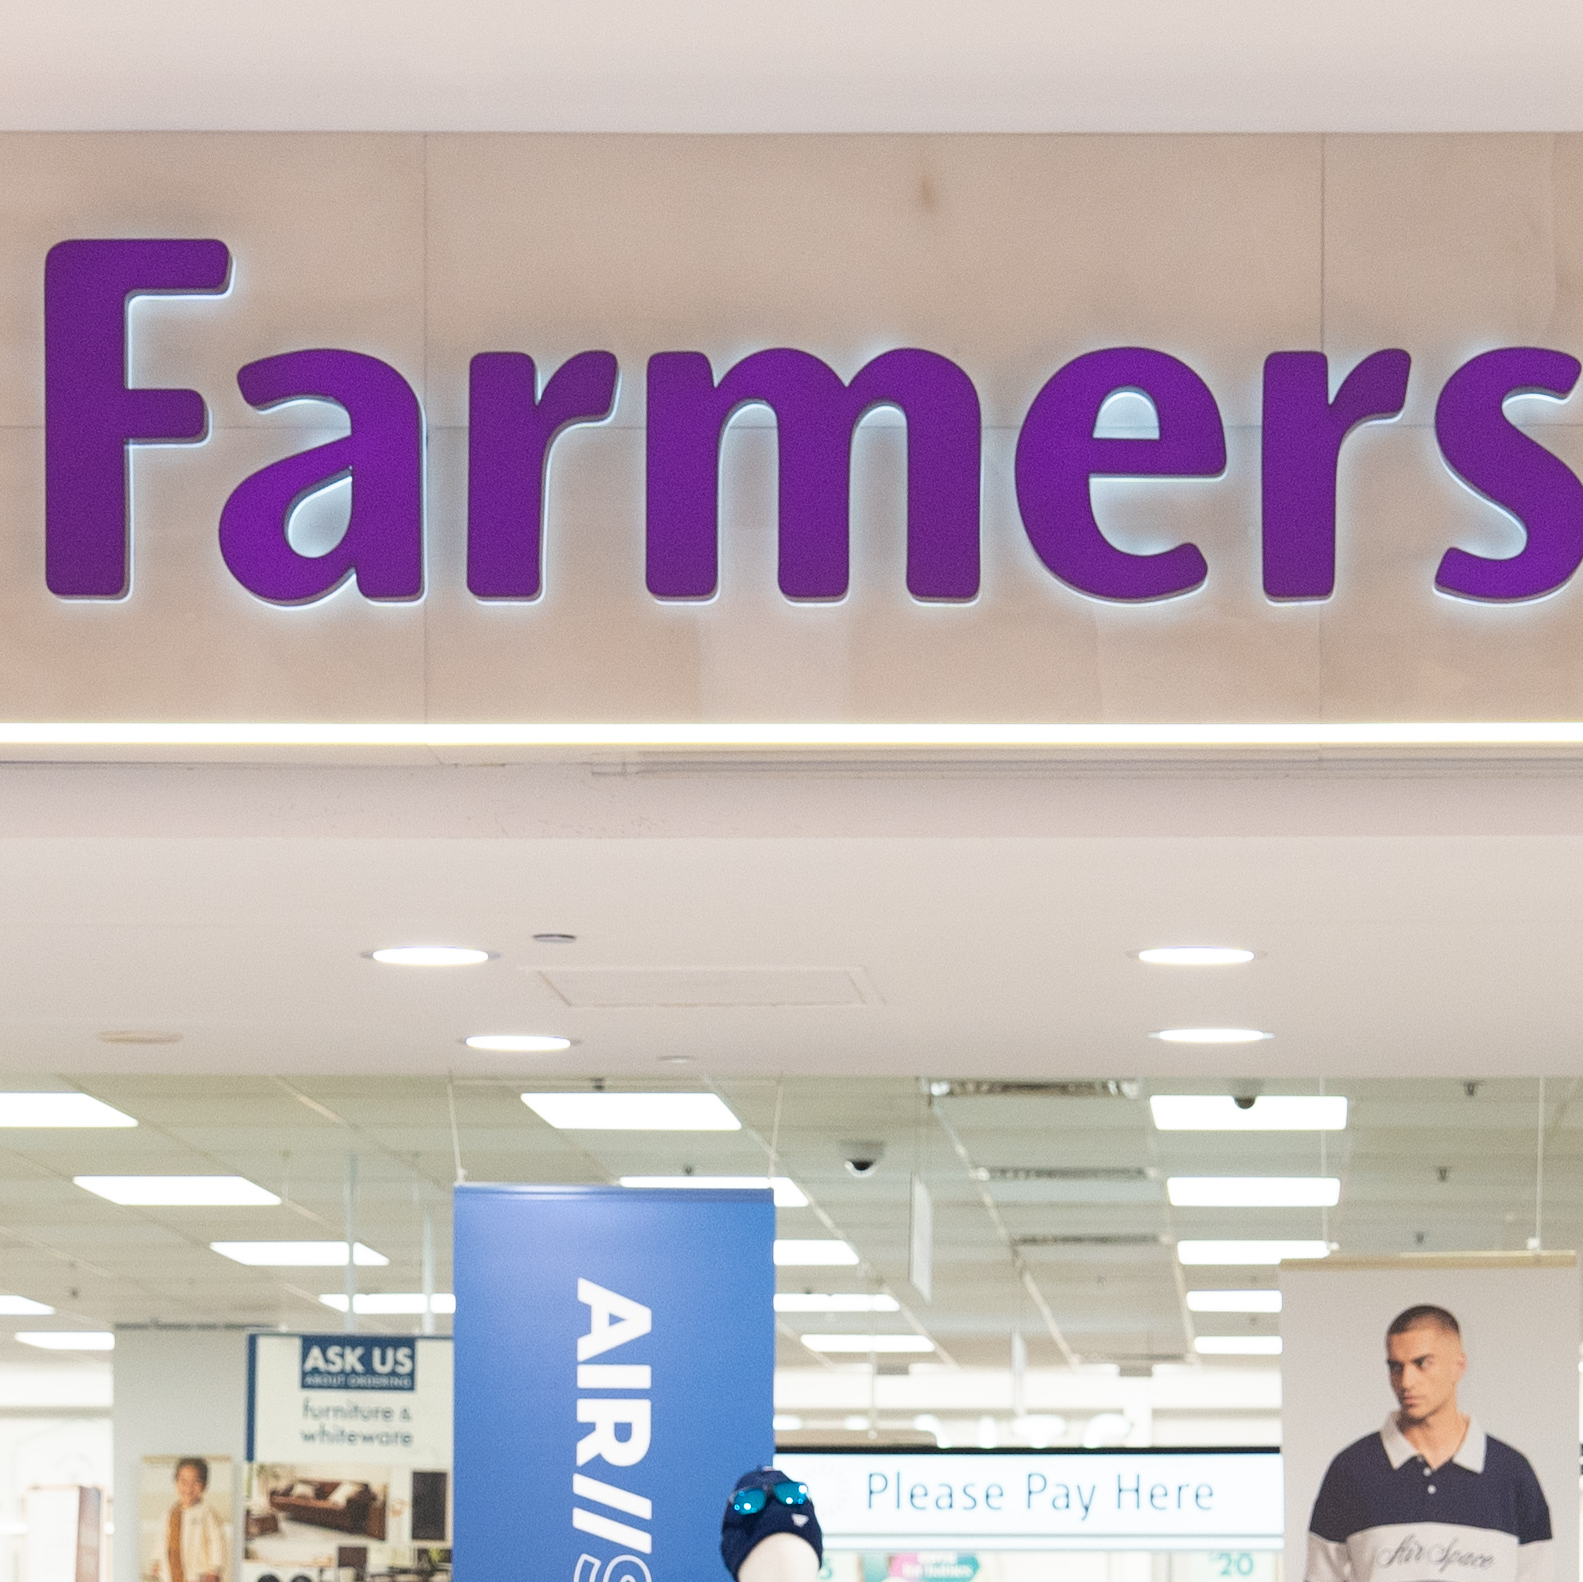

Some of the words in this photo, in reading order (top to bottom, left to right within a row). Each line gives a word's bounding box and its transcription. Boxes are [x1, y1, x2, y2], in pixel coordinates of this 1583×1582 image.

[303, 1345, 366, 1373] ASK
[371, 1346, 414, 1375] US
[303, 1397, 394, 1420] furniture
[300, 1424, 414, 1446] whiteware
[867, 1471, 1005, 1511] Please
[1026, 1472, 1097, 1522] Pay
[1116, 1473, 1215, 1511] Here
